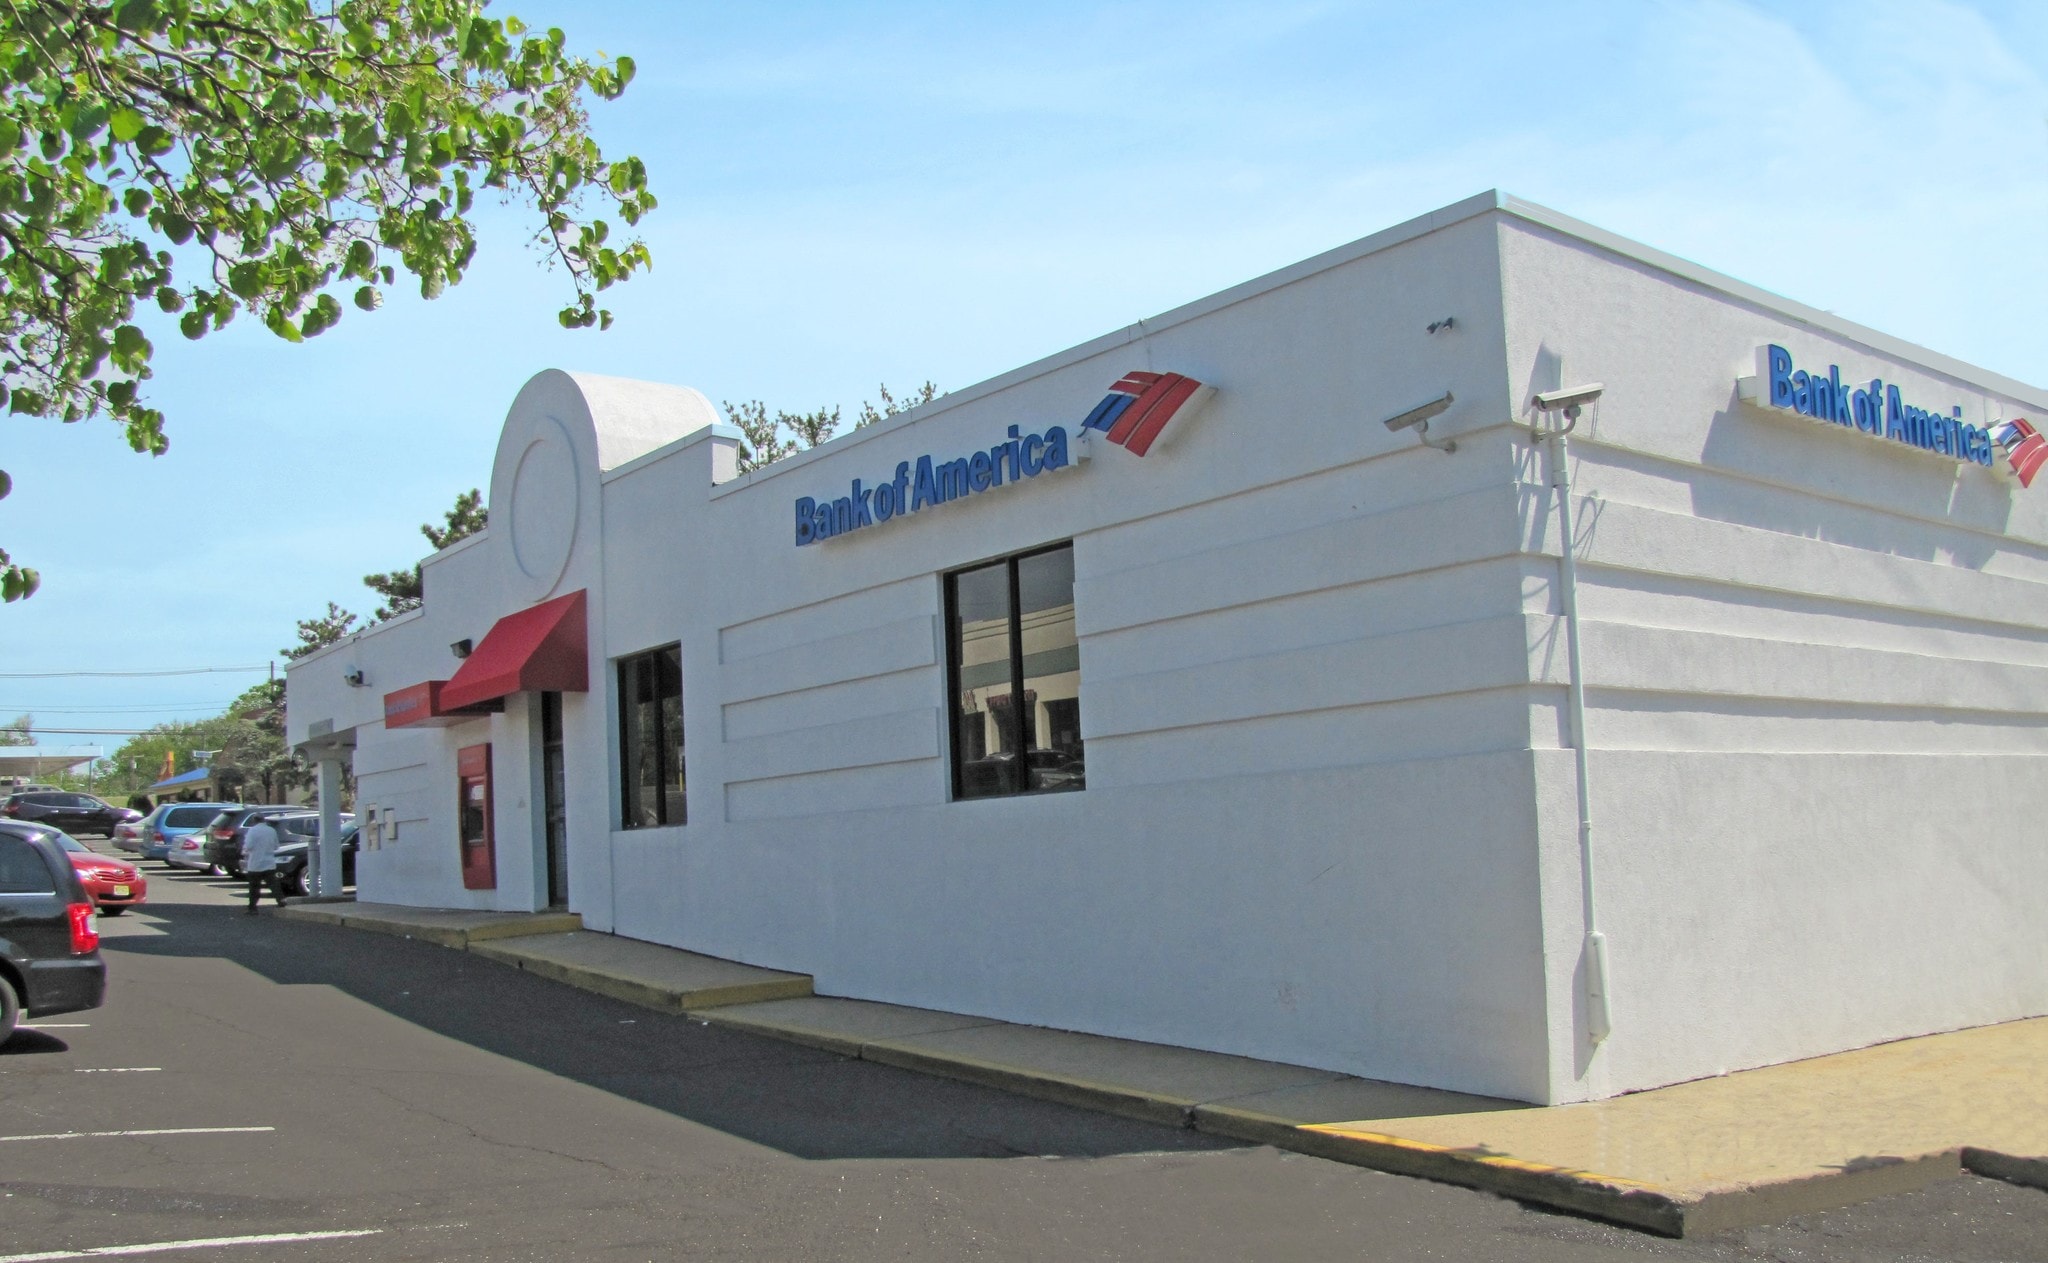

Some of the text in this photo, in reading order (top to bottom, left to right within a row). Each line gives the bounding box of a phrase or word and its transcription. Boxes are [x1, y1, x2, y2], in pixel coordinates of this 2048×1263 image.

[1768, 343, 1993, 467] Bank of America
[796, 424, 1069, 547] Bank of America
